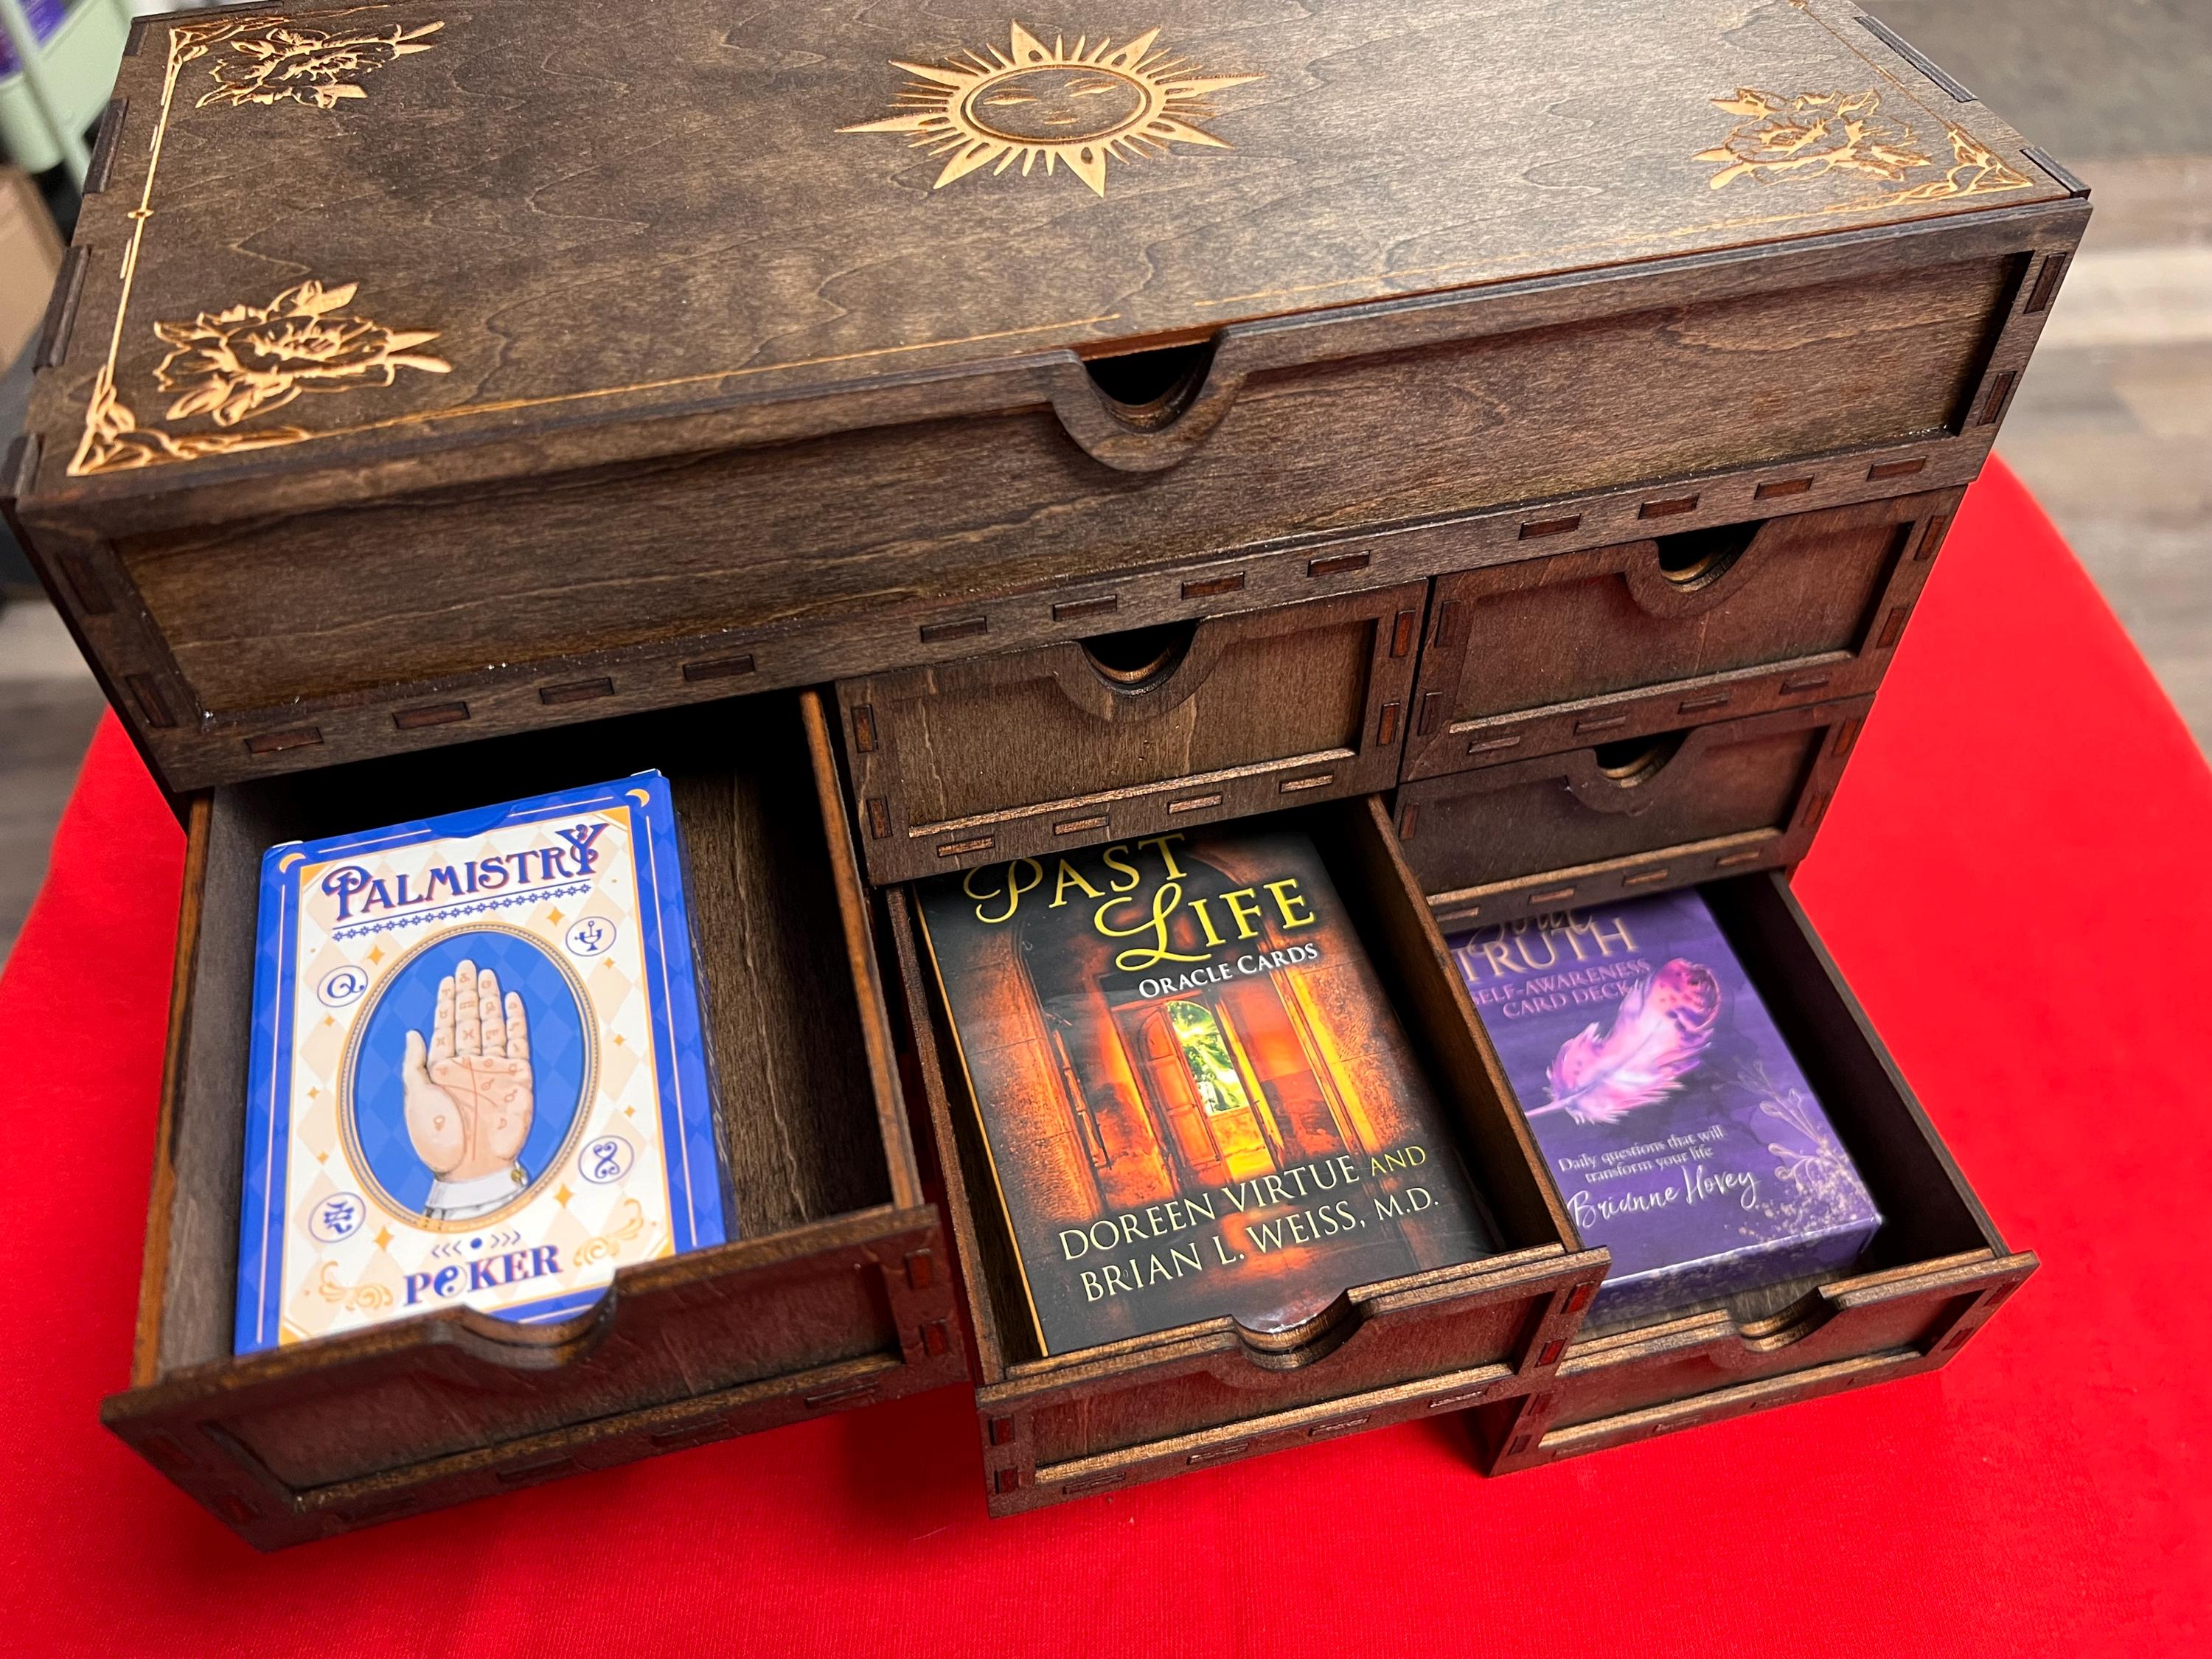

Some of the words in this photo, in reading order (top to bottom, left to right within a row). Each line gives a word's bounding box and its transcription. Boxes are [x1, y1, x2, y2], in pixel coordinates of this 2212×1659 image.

[321, 822, 610, 922] PALMISTRY
[963, 834, 1187, 924] PAST
[1093, 878, 1315, 972] LIFE
[1450, 917, 1640, 983] TRUTH
[1138, 962, 1234, 998] ORACLE
[1237, 942, 1318, 975] CARDS
[1502, 992, 1568, 1020] CARD
[1571, 978, 1632, 1005] DECK
[1558, 1154, 1596, 1172] Daily
[1601, 1142, 1666, 1164] questions
[1666, 1133, 1697, 1149] that
[1697, 1124, 1724, 1143] will
[1585, 1161, 1654, 1183] transform
[1654, 1150, 1688, 1172] your
[1688, 1144, 1716, 1161] life
[1058, 1192, 1217, 1261] DOREEN
[1221, 1154, 1360, 1213] VIRTUE
[1369, 1144, 1427, 1178] AND
[403, 1243, 565, 1307] POKER
[1079, 1242, 1203, 1303] BRIAN
[1212, 1234, 1245, 1266] L.
[1245, 1200, 1365, 1253] WEISS,
[1373, 1186, 1440, 1220] M.D.
